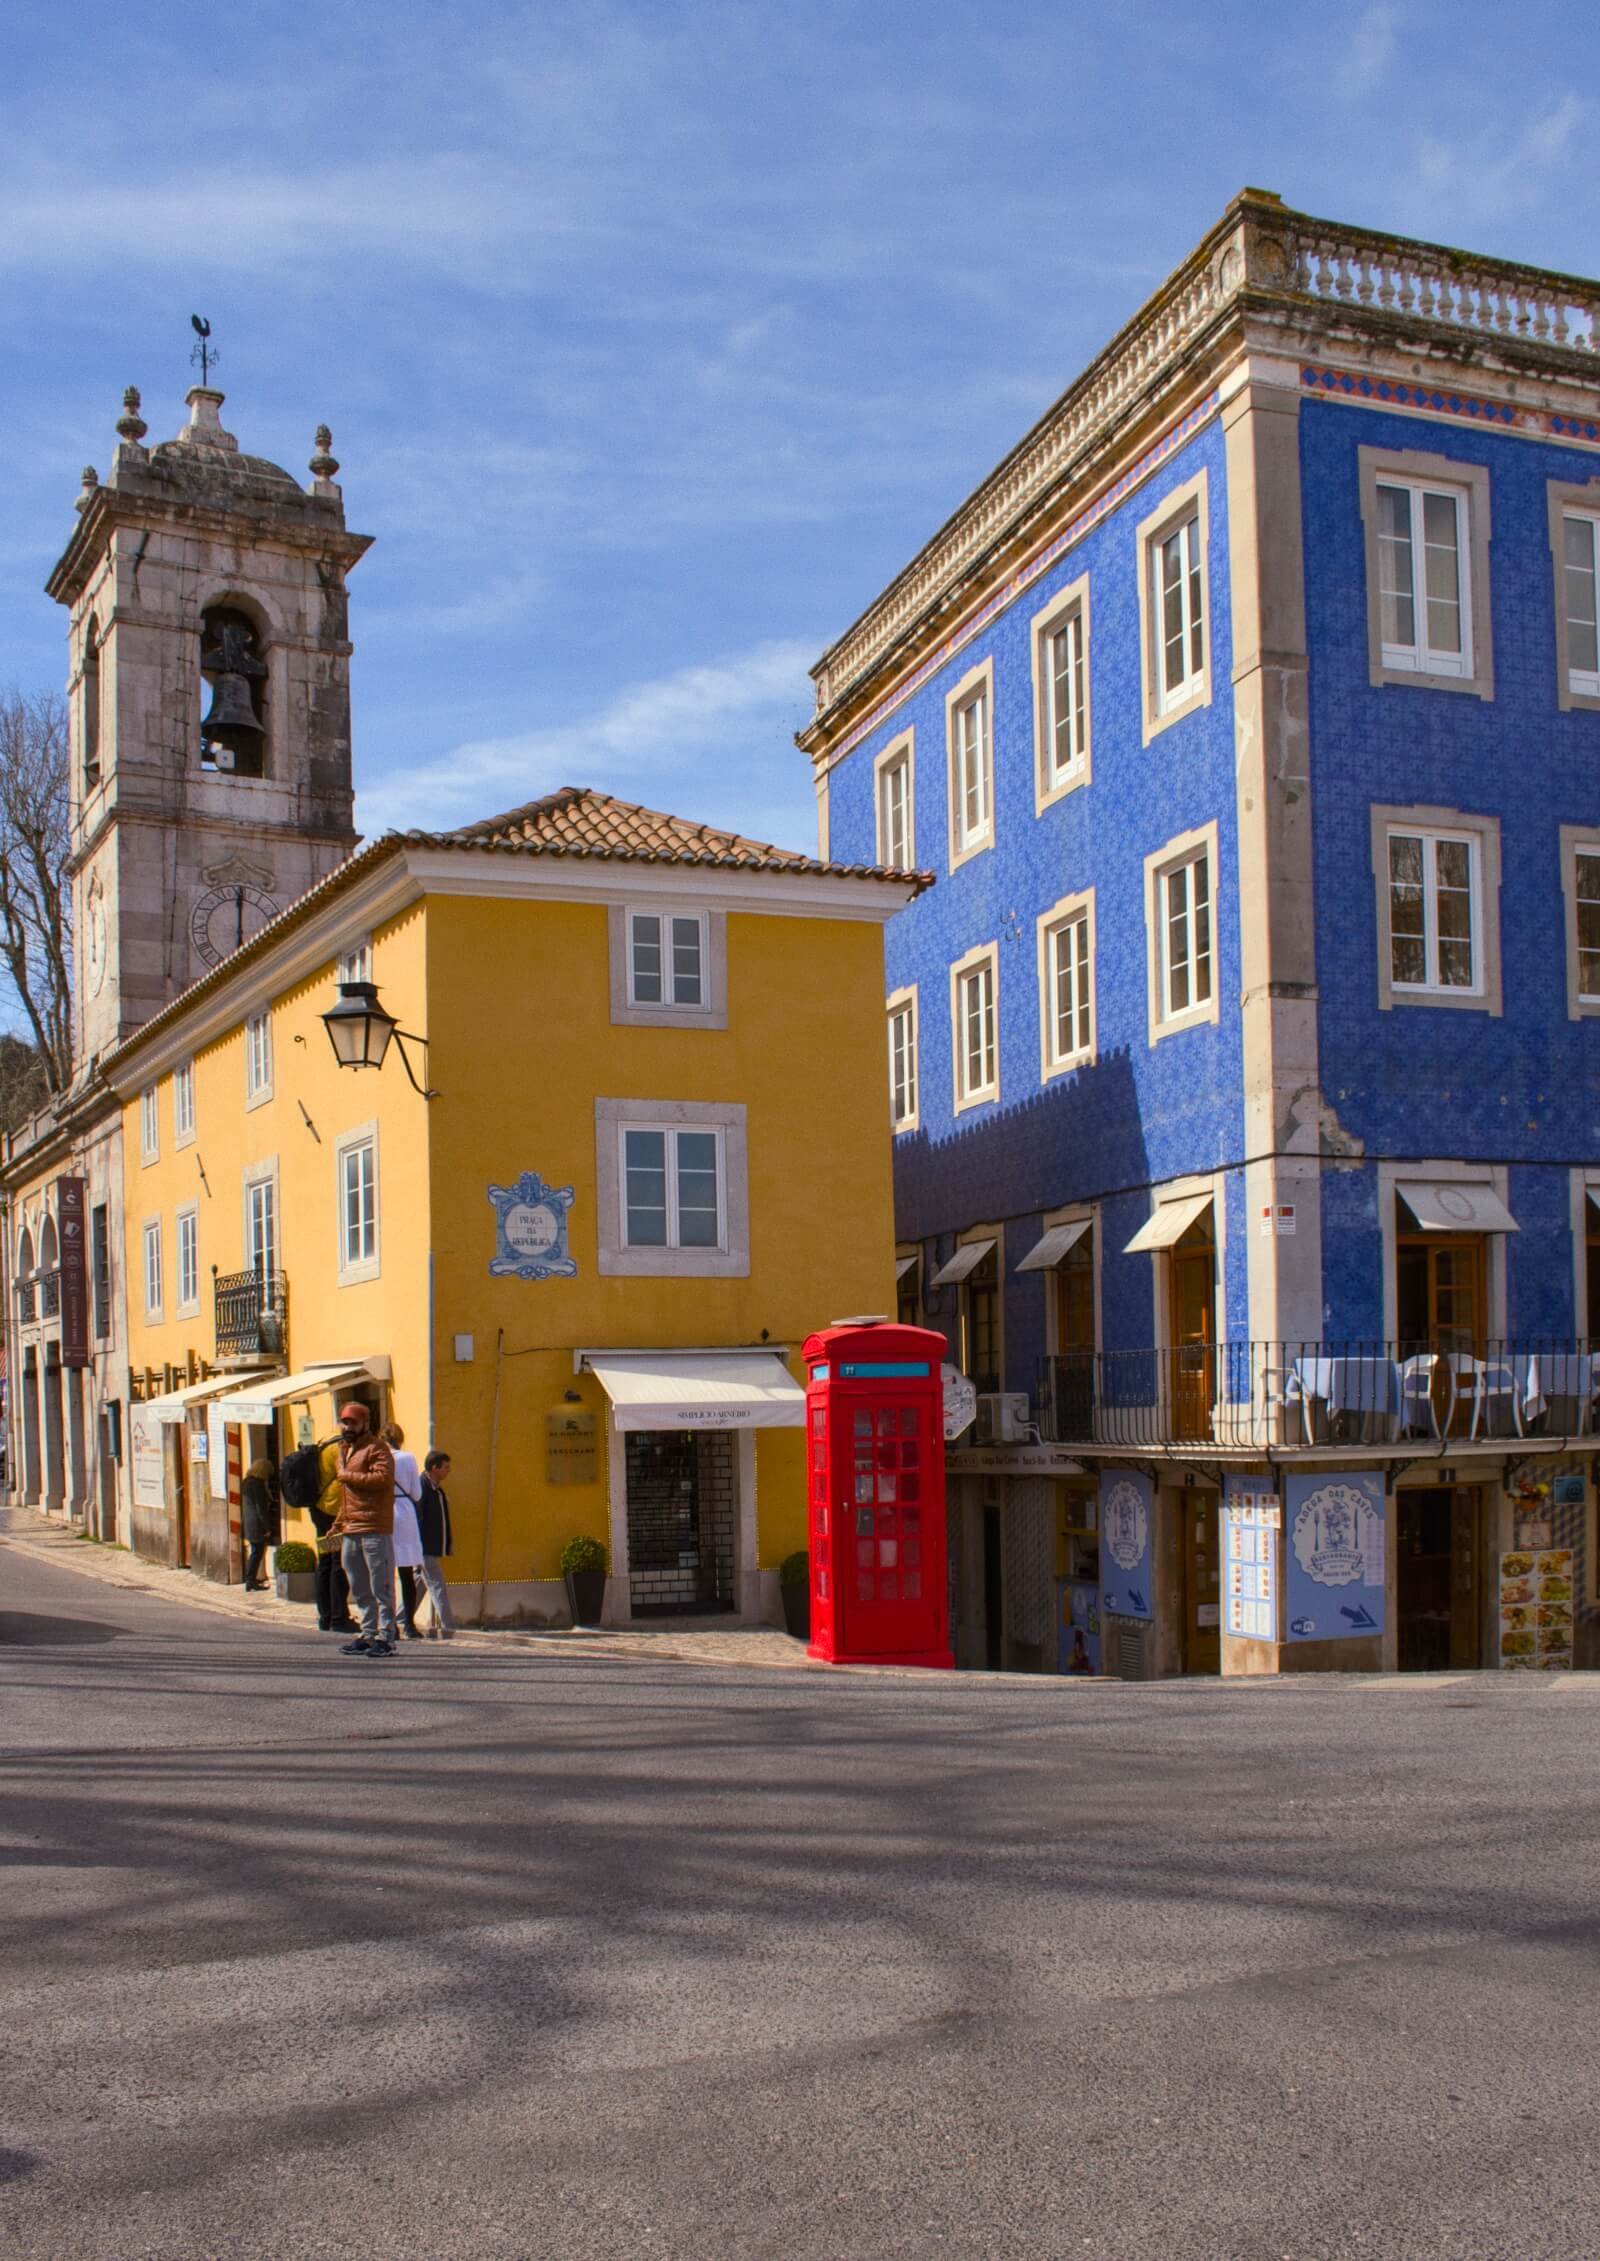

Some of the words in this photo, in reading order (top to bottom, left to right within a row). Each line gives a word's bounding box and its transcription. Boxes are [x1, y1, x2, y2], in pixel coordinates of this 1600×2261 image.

[1299, 1496, 1323, 1524] ADEGA
[1328, 1490, 1345, 1498] DAS
[1350, 1493, 1373, 1519] CAVES
